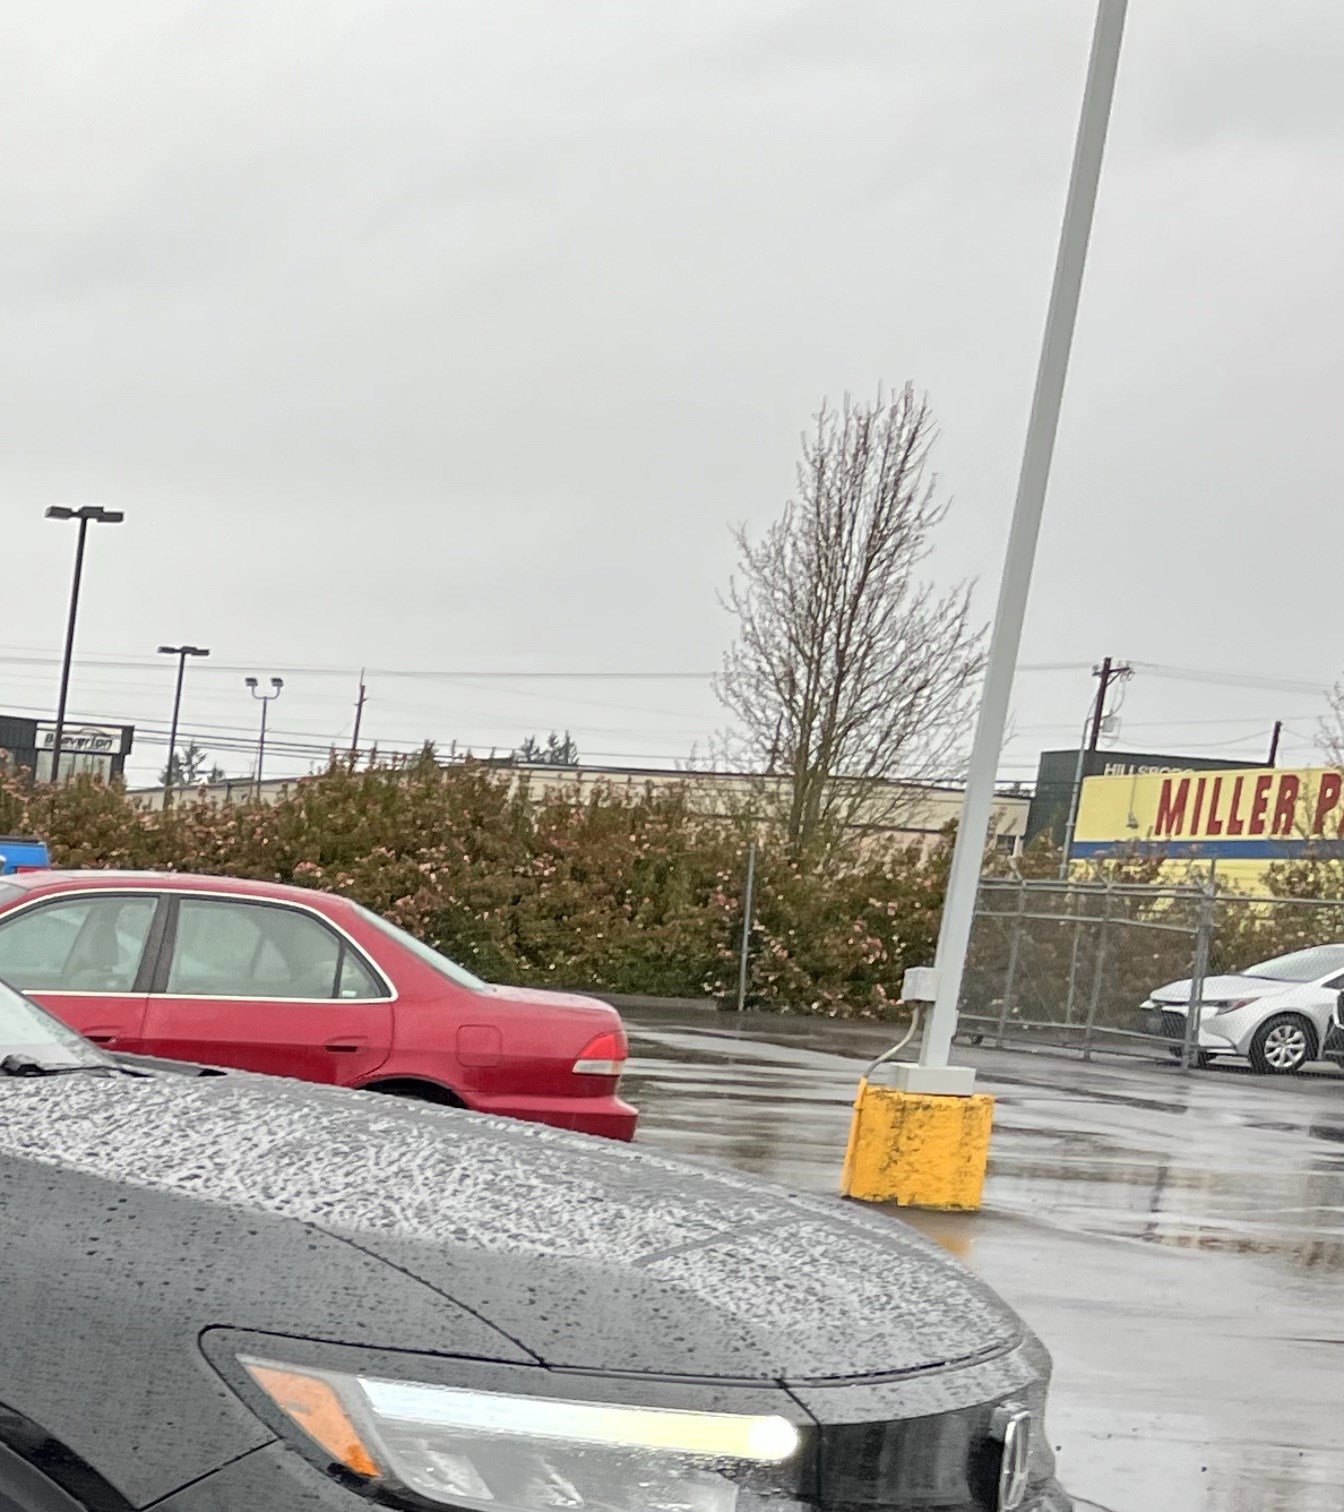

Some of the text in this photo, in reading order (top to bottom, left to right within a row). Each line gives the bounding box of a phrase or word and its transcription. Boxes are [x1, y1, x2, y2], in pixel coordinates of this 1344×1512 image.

[43, 732, 113, 751] Baverton
[1154, 772, 1344, 836] MILLER P
